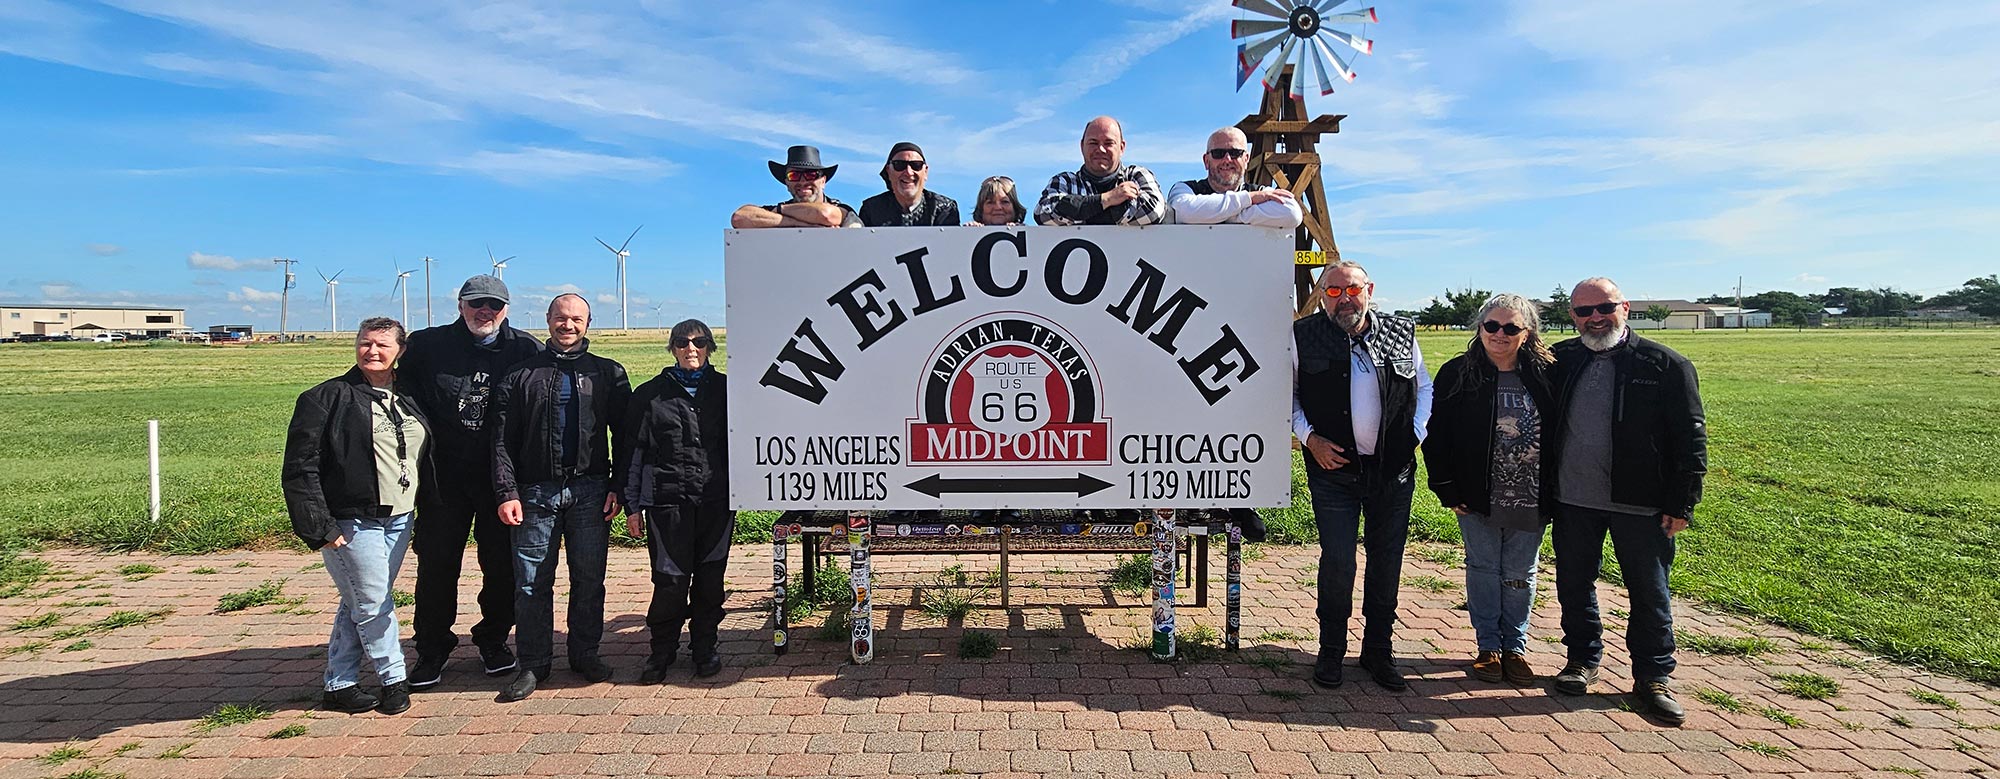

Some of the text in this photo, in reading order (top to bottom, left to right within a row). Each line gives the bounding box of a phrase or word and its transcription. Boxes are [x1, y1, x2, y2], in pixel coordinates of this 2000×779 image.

[759, 231, 1260, 406] WELCOME
[933, 322, 1087, 382] ADRIAN, TEXAS
[985, 362, 1037, 376] ROUTE
[1000, 378, 1022, 390] US
[981, 392, 1038, 423] 66
[755, 435, 901, 466] LOS ANGELES
[926, 427, 1092, 460] MIDPOINT
[1119, 433, 1265, 465] CHICAGO
[764, 471, 888, 501] 1139 MILES
[1127, 469, 1251, 500] 1139 MILES
[1091, 526, 1133, 534] EMILIA
[854, 625, 868, 638] 66
